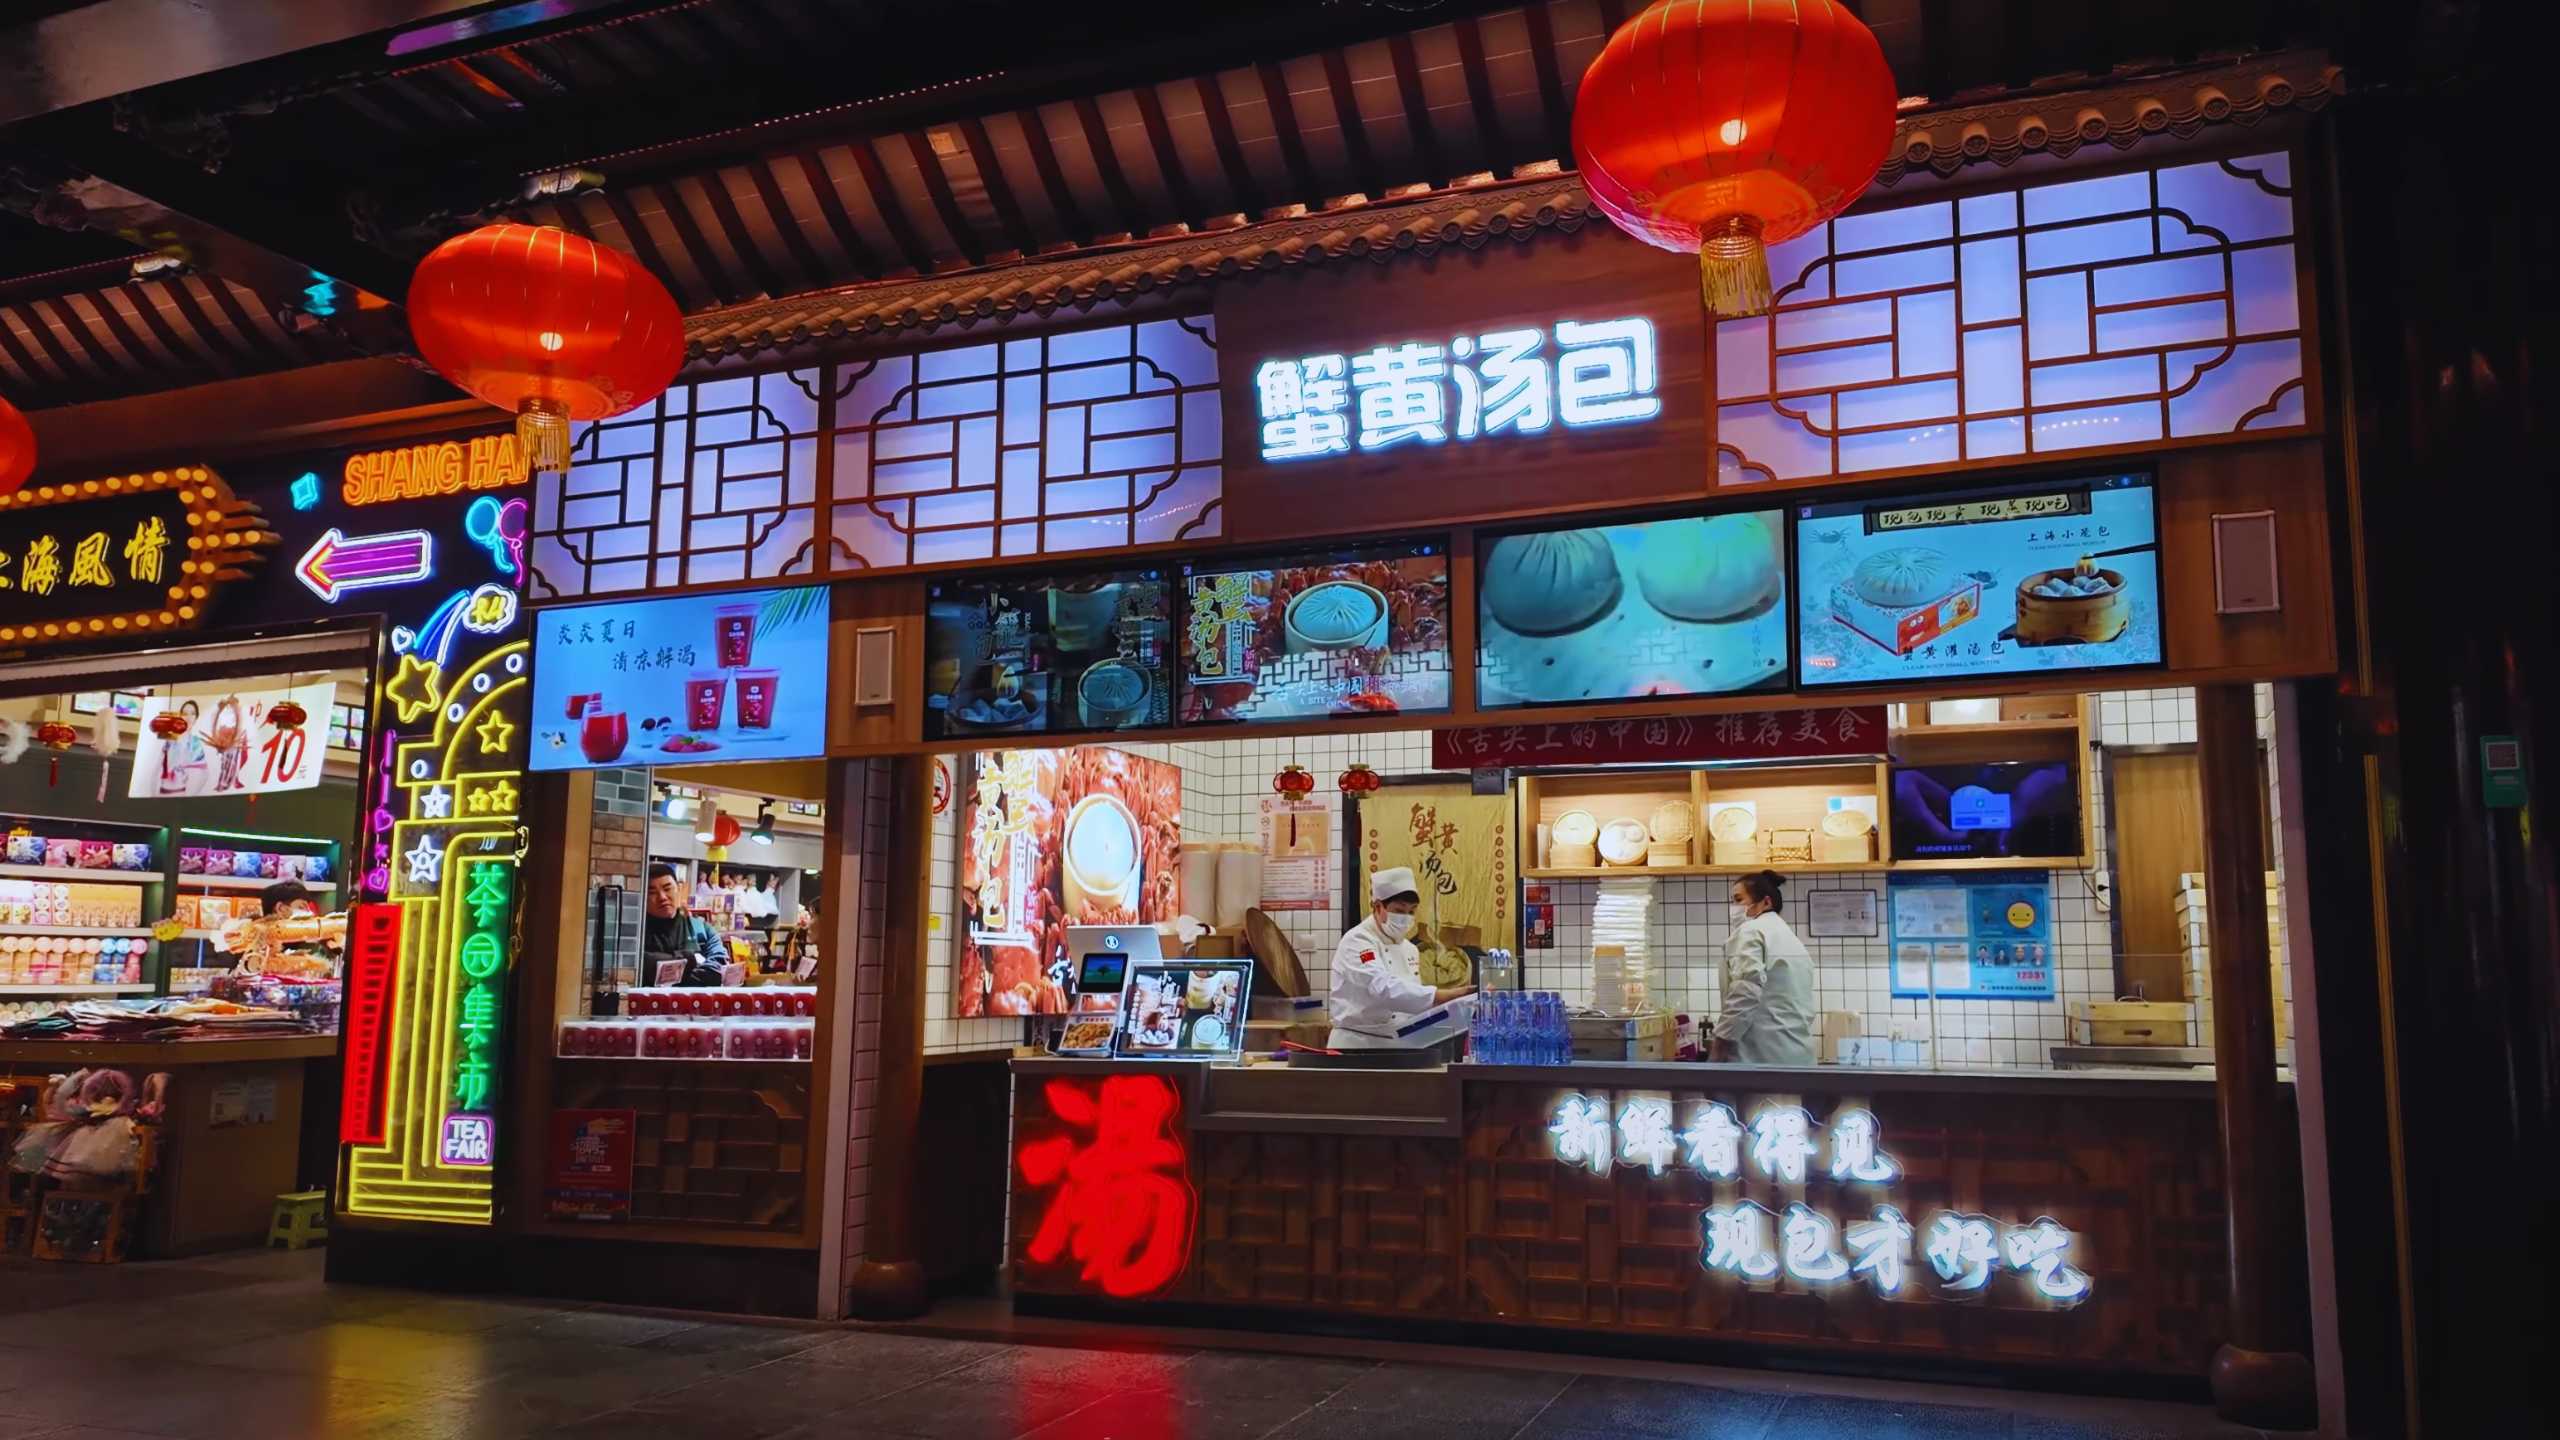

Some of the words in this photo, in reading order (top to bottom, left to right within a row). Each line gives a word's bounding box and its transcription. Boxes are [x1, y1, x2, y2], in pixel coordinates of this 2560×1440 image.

[1256, 316, 1660, 463] 蟹黄汤包
[343, 440, 464, 506] SHANG
[0, 516, 170, 596] 海風情
[558, 618, 636, 645] 炎炎夏日
[260, 728, 306, 784] 10
[1409, 802, 1460, 895] 蟹黄汤包
[445, 1138, 488, 1160] FAIR
[449, 1119, 486, 1139] TEA
[1550, 1094, 1897, 1184] 新鲜看得见
[1705, 1203, 2093, 1302] 现包才好吃
